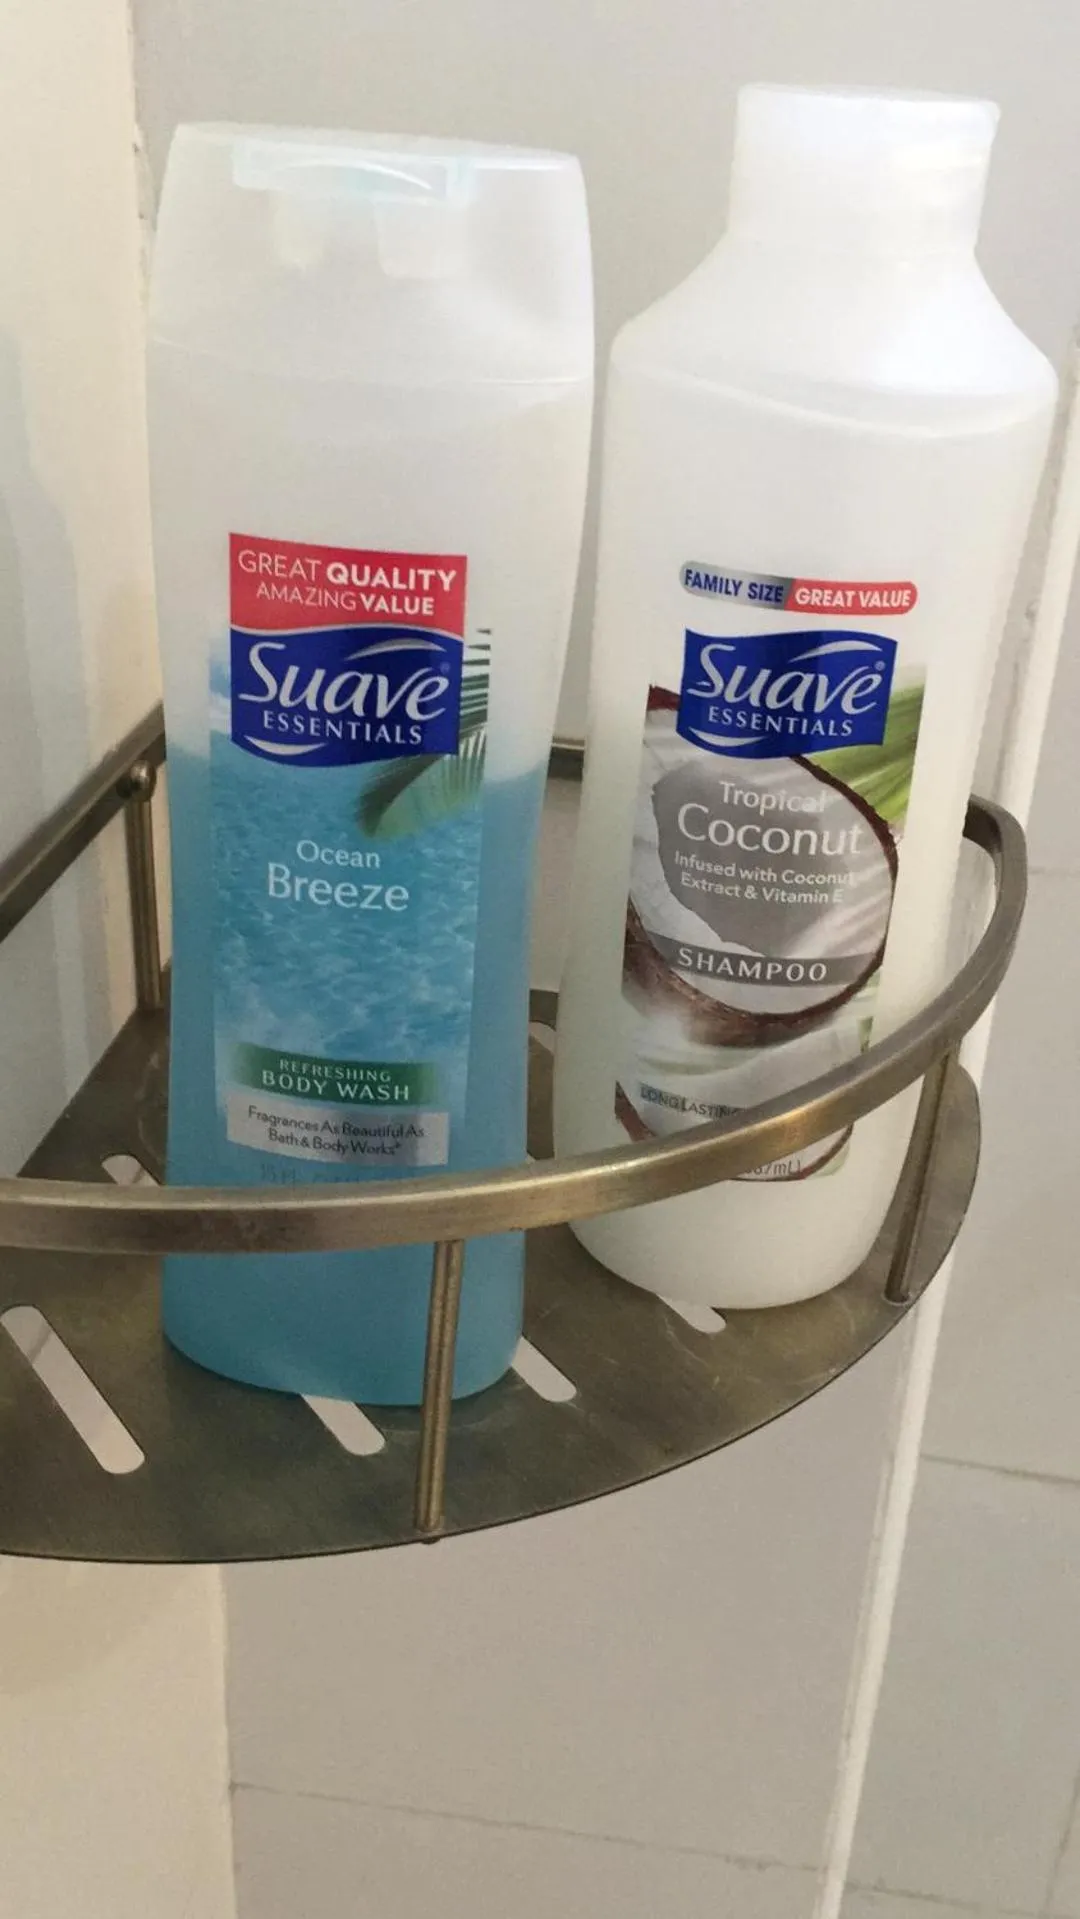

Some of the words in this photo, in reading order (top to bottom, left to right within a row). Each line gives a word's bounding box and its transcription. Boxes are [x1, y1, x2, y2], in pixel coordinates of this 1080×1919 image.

[238, 550, 321, 581] GREAT
[326, 562, 456, 592] QUALITY
[684, 569, 742, 597] FAMILY
[747, 582, 784, 604] SIZE
[795, 588, 855, 606] GREAT
[860, 590, 911, 608] VALUE
[256, 582, 356, 611] AMAZING
[359, 593, 434, 616] VALUE
[238, 641, 449, 721] Suave
[687, 643, 882, 715] Suave
[263, 710, 422, 745] ESSENTIALS
[708, 706, 853, 737] ESSENTIALS
[720, 781, 827, 815] Tropical
[678, 803, 863, 855] Coconut
[296, 839, 381, 869] Ocean
[674, 850, 736, 877] Infused
[739, 867, 777, 882] with
[781, 869, 855, 885] Coconut
[267, 862, 409, 911] Breeze
[681, 871, 740, 897] Extract
[744, 886, 758, 899] &
[762, 887, 829, 903] Vitamin
[832, 890, 844, 903] E
[677, 947, 828, 982] SHAMPOO
[261, 1070, 327, 1095] BODY
[336, 1083, 409, 1100] WASH
[279, 1059, 391, 1082] REFRESHING
[248, 1104, 318, 1132] Fragrances
[320, 1120, 339, 1135] As
[342, 1121, 403, 1139] Beautiful
[405, 1123, 424, 1138] As
[268, 1127, 300, 1146] Bath
[301, 1137, 310, 1148] &
[312, 1135, 349, 1155] Body
